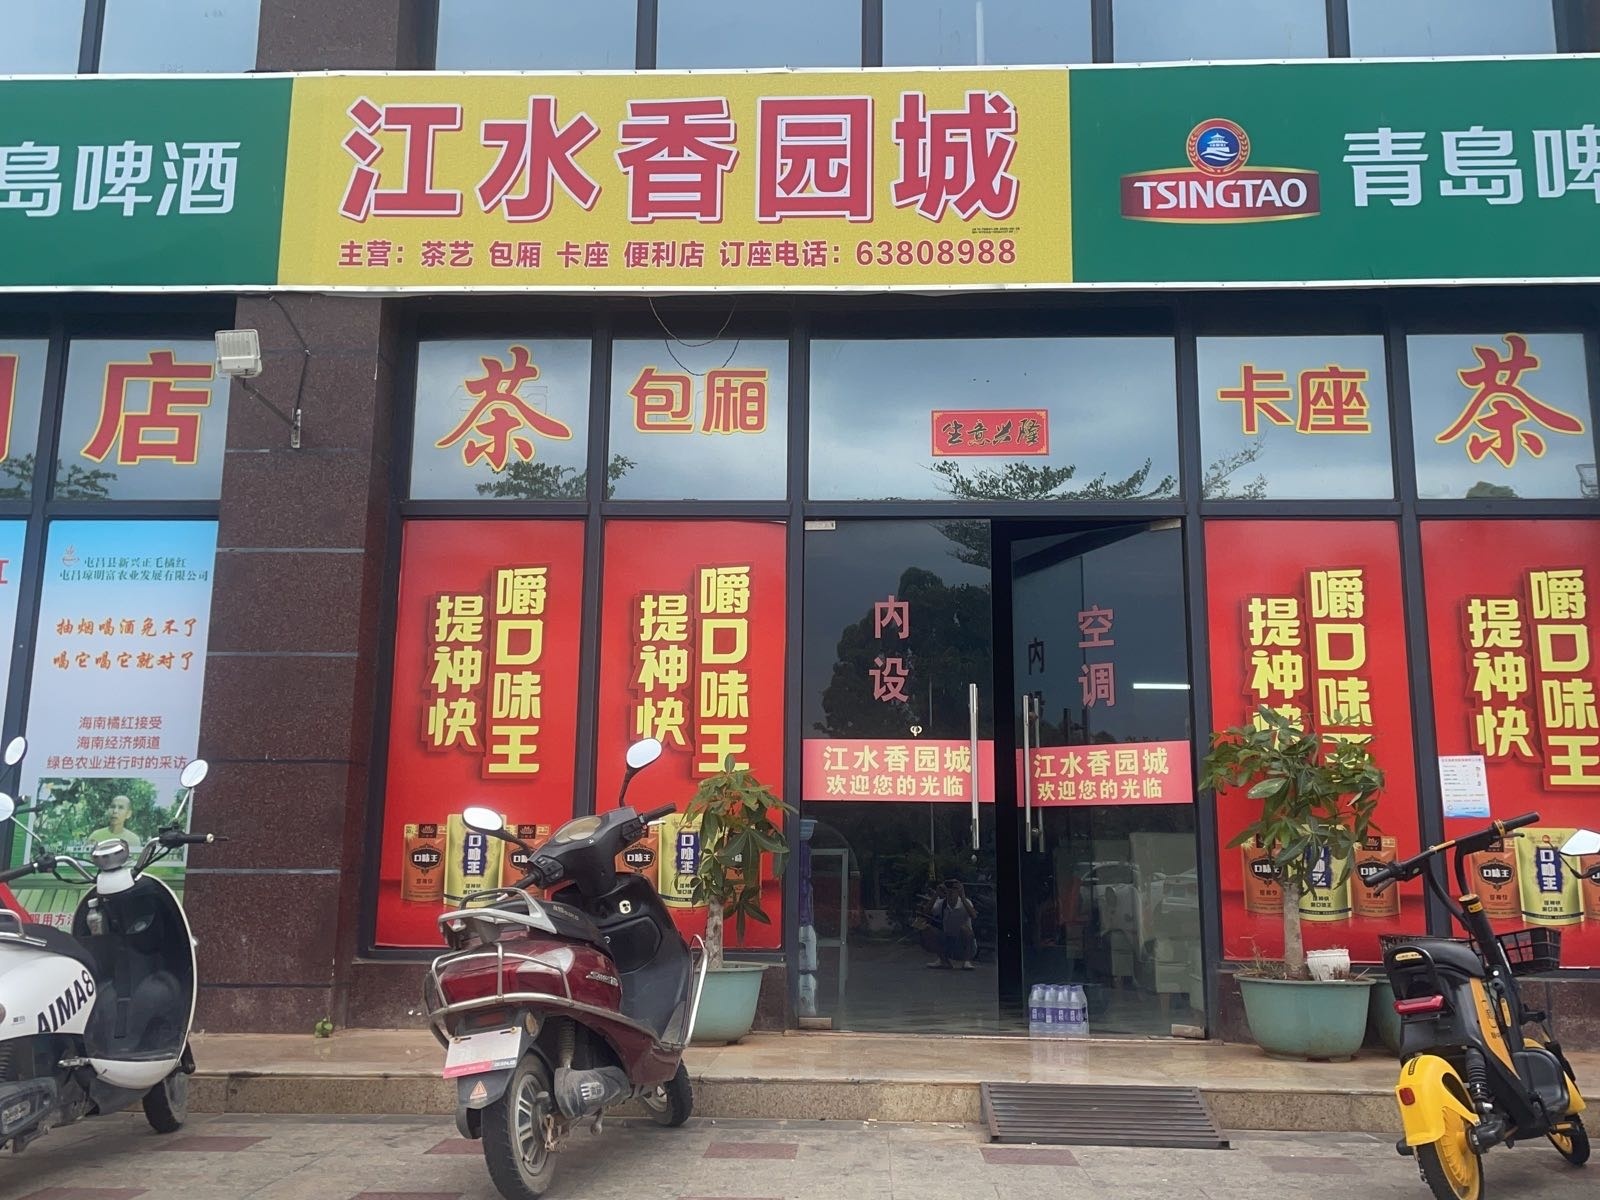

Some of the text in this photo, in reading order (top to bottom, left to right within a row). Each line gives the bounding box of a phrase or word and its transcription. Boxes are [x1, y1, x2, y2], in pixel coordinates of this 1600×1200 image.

[339, 92, 1020, 225] 江水香园城
[1342, 124, 1600, 207] 青島啤
[1133, 177, 1308, 211] TSINGTAO
[421, 241, 473, 268] 茶艺
[489, 241, 542, 268] 包厢
[557, 241, 610, 268] 卡座
[623, 240, 705, 268] 便利店
[855, 239, 1017, 265] 63808988
[80, 350, 215, 465] 店
[434, 344, 572, 471] 茶
[627, 366, 768, 434] 包厢
[1217, 363, 1372, 435] 卡座
[1434, 332, 1585, 468] 茶
[942, 418, 1041, 447] 生意兴隆
[56, 617, 197, 637] 抽烟喝酒免不了
[53, 651, 194, 670] 喝它喝它就对了
[698, 565, 751, 772] 嚼口味王
[869, 594, 911, 703] 内设
[1077, 604, 1117, 708] 空调
[428, 594, 484, 747] 提神快
[488, 566, 547, 774] 嚼口味王
[636, 594, 690, 746] 提神快
[1466, 598, 1535, 758] 提神快
[1529, 569, 1600, 787] 嚼口味王
[46, 755, 188, 770] 绿色农业进行时的采访
[76, 736, 161, 750] 海南经济频道
[823, 745, 972, 772] 江水香园城
[1033, 746, 1170, 778] 江水香园城
[826, 774, 964, 797] 欢迎您的光临
[1037, 776, 1163, 802] 欢迎您的光临
[466, 834, 482, 874] 口味王
[626, 853, 651, 863] 口味王
[680, 834, 695, 874] 口味王
[1482, 867, 1510, 879] 口味王
[1540, 849, 1558, 891] 口味王
